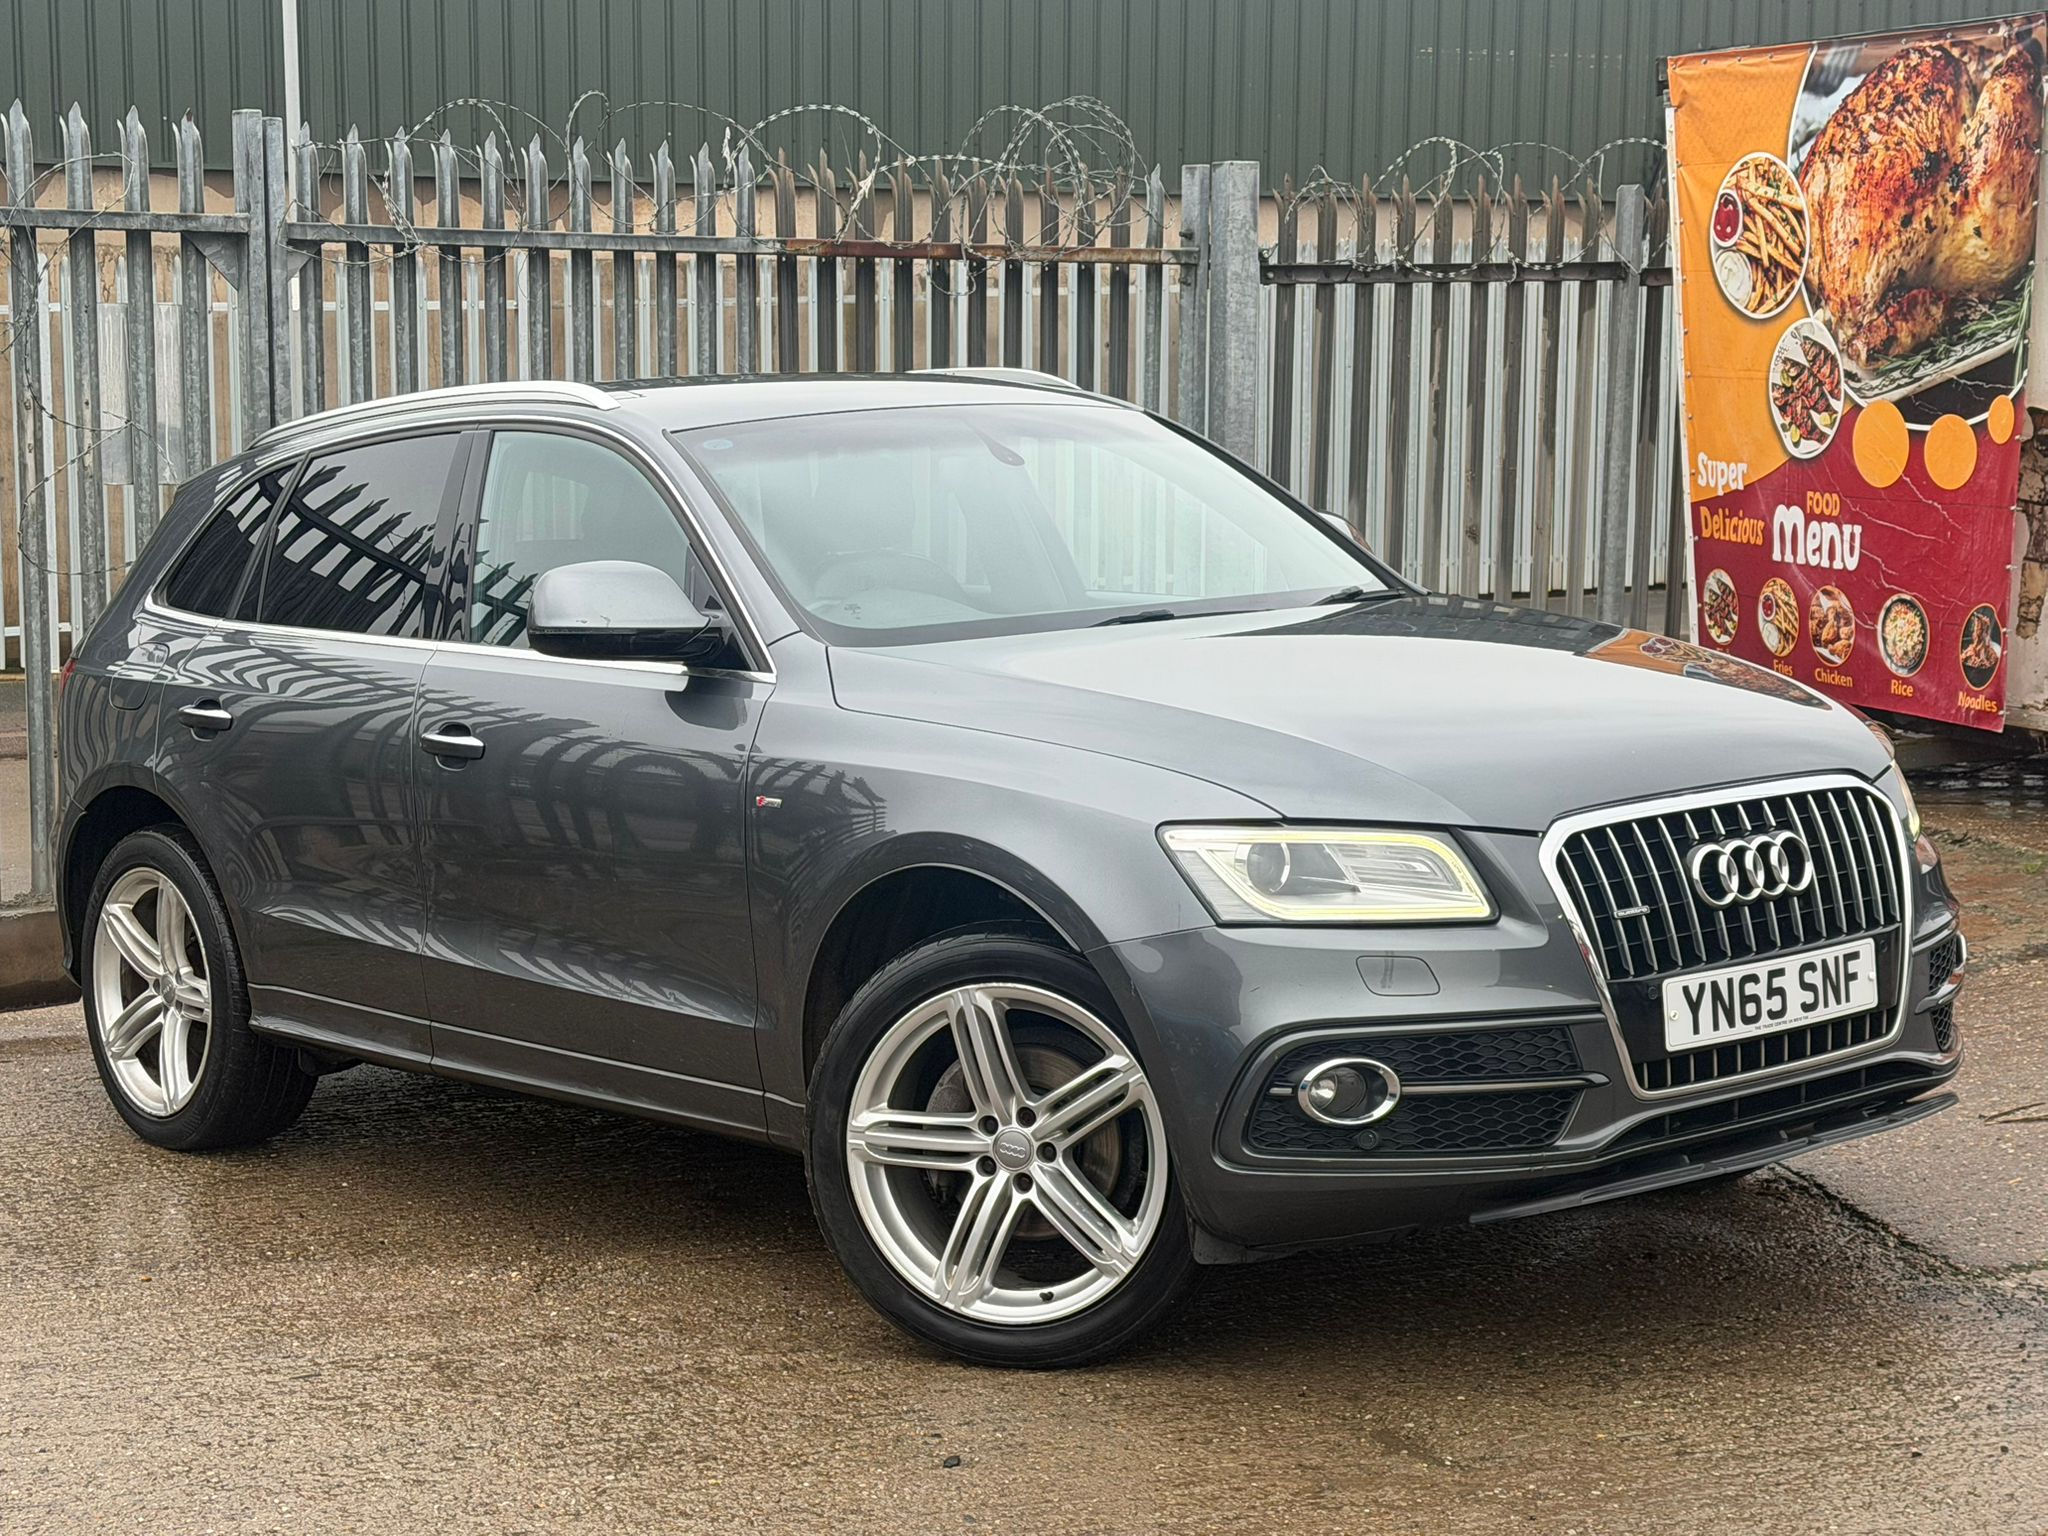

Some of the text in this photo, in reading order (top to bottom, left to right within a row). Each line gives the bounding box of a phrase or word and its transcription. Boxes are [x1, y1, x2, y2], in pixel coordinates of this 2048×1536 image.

[1697, 451, 1748, 496] Super
[1806, 490, 1841, 517] FOOD
[1699, 505, 1765, 545] Delicious
[1772, 503, 1863, 571] Menu
[1773, 659, 1793, 677] Fries
[1814, 667, 1853, 688] Chicken
[1890, 679, 1914, 697] Rice
[1958, 690, 1998, 713] Noodles
[1681, 950, 1862, 1036] YN65 SNF
